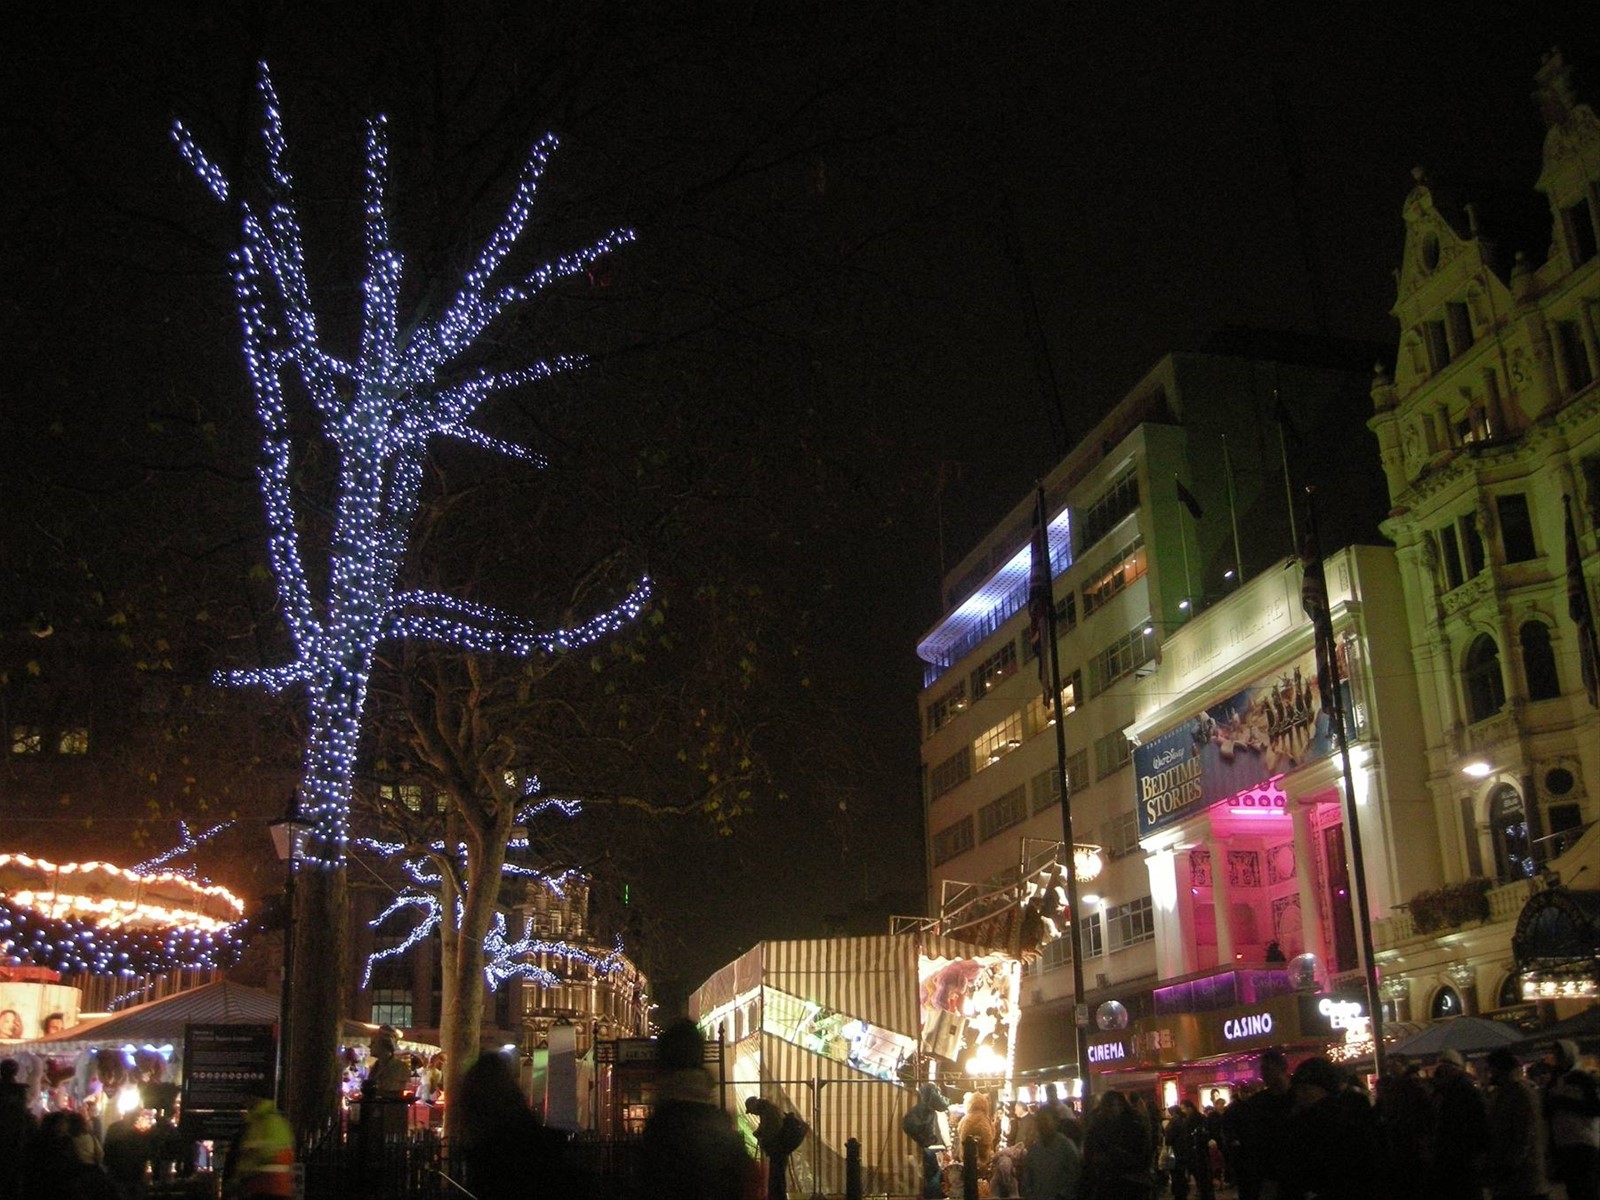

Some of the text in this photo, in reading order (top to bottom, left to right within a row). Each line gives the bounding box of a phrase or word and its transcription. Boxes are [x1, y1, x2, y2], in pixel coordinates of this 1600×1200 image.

[1141, 756, 1202, 802] BEDTIME
[1146, 777, 1203, 826] STORIES
[1223, 1012, 1272, 1040] CASINO
[1087, 1041, 1125, 1063] CINEMA
